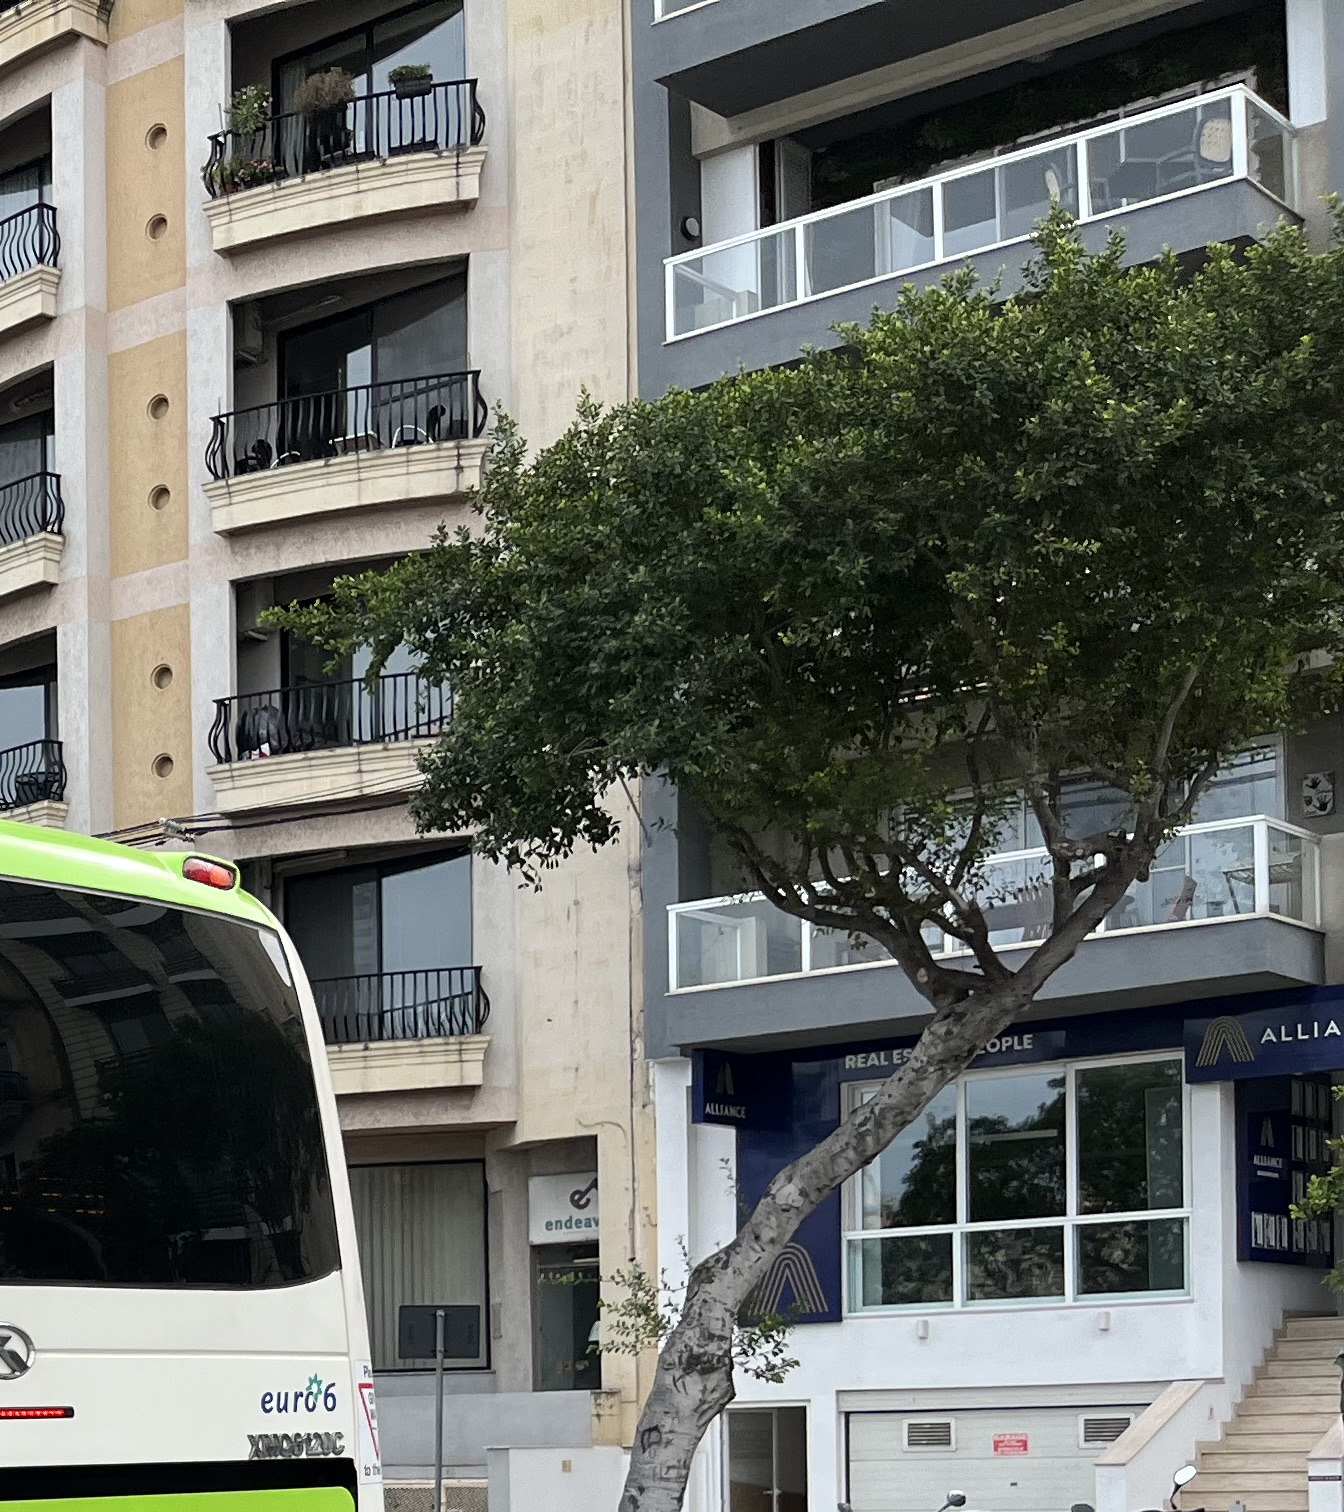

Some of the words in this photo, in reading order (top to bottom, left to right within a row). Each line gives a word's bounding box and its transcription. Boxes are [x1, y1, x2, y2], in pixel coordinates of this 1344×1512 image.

[845, 1051, 889, 1069] REAL
[978, 1034, 1034, 1055] OPLE
[705, 1102, 746, 1119] ALLIANCE
